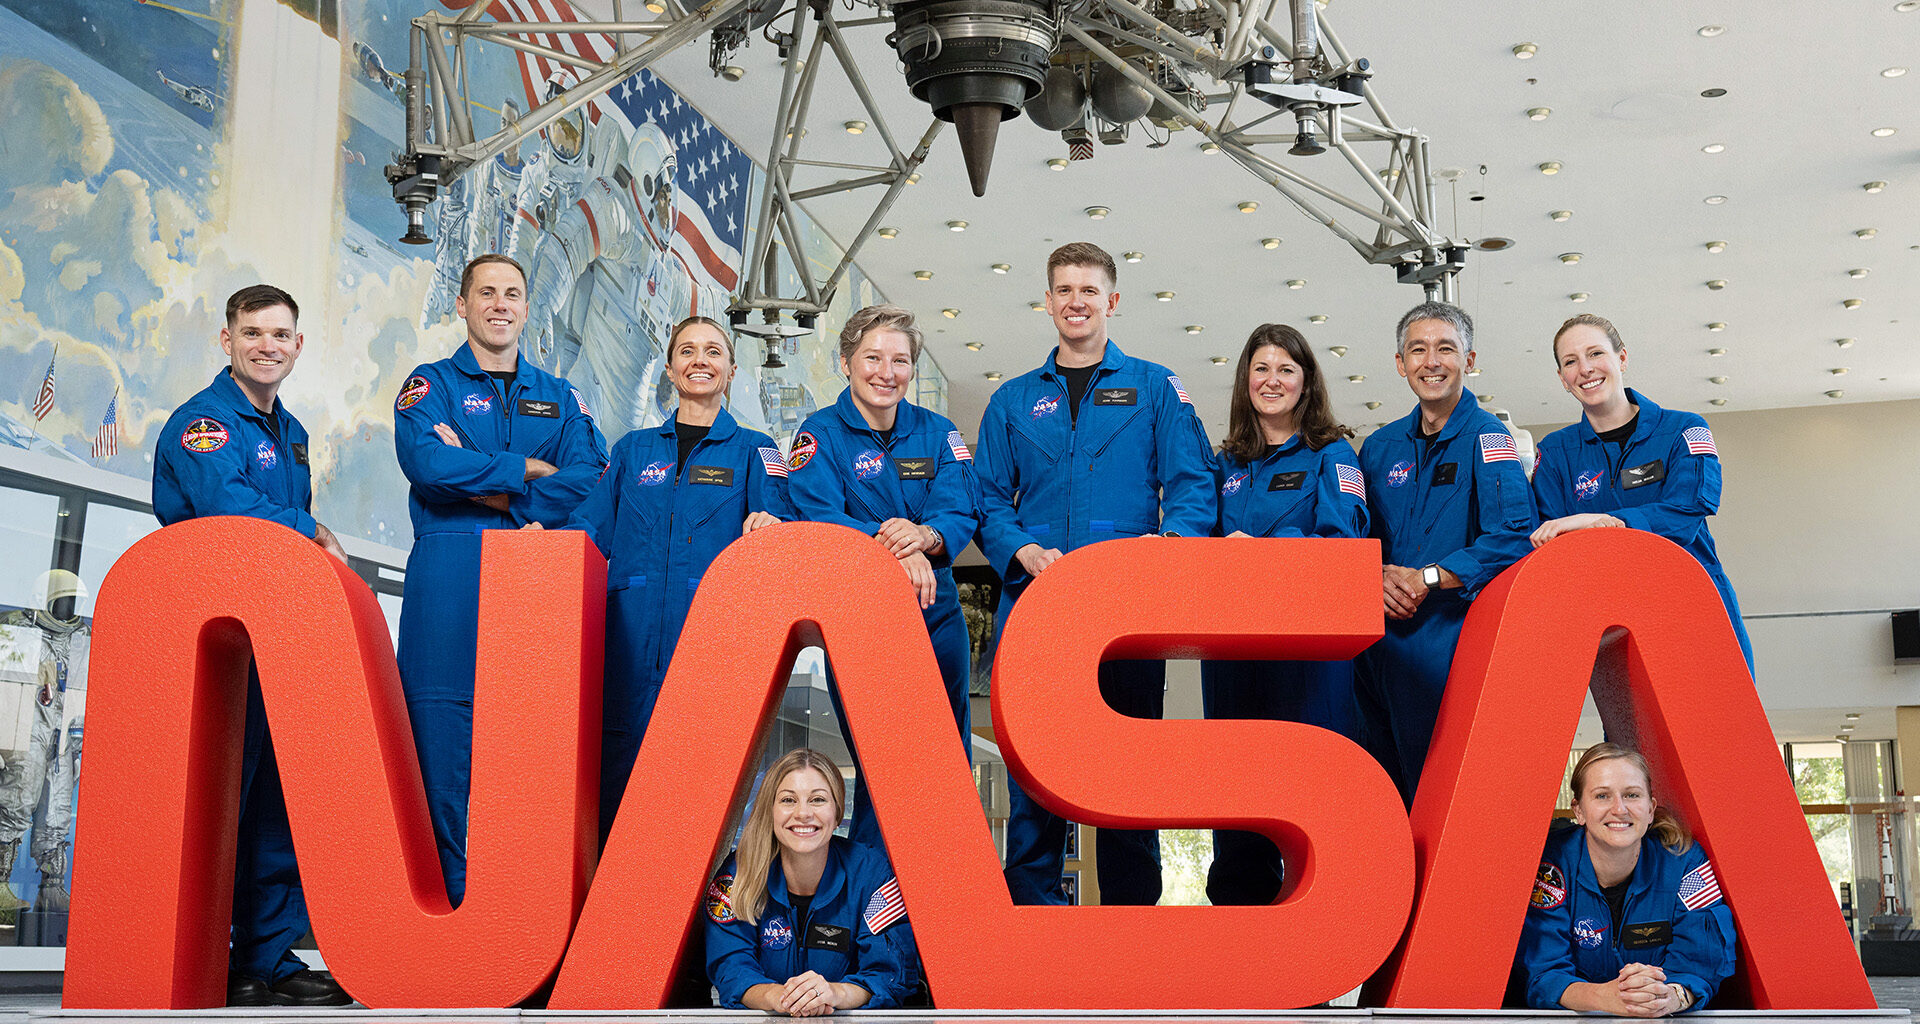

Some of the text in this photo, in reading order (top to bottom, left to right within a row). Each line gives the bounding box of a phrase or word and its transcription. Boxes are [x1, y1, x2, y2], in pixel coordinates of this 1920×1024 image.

[464, 399, 491, 409] NASA
[1033, 401, 1058, 411] NASA
[855, 459, 882, 470] NASA
[642, 468, 665, 477] NASA
[1575, 480, 1599, 491] NASA
[63, 515, 1876, 1009] NASA
[1538, 881, 1565, 901] OPERATIONS
[764, 926, 792, 938] NASA
[1573, 927, 1603, 941] NASA
